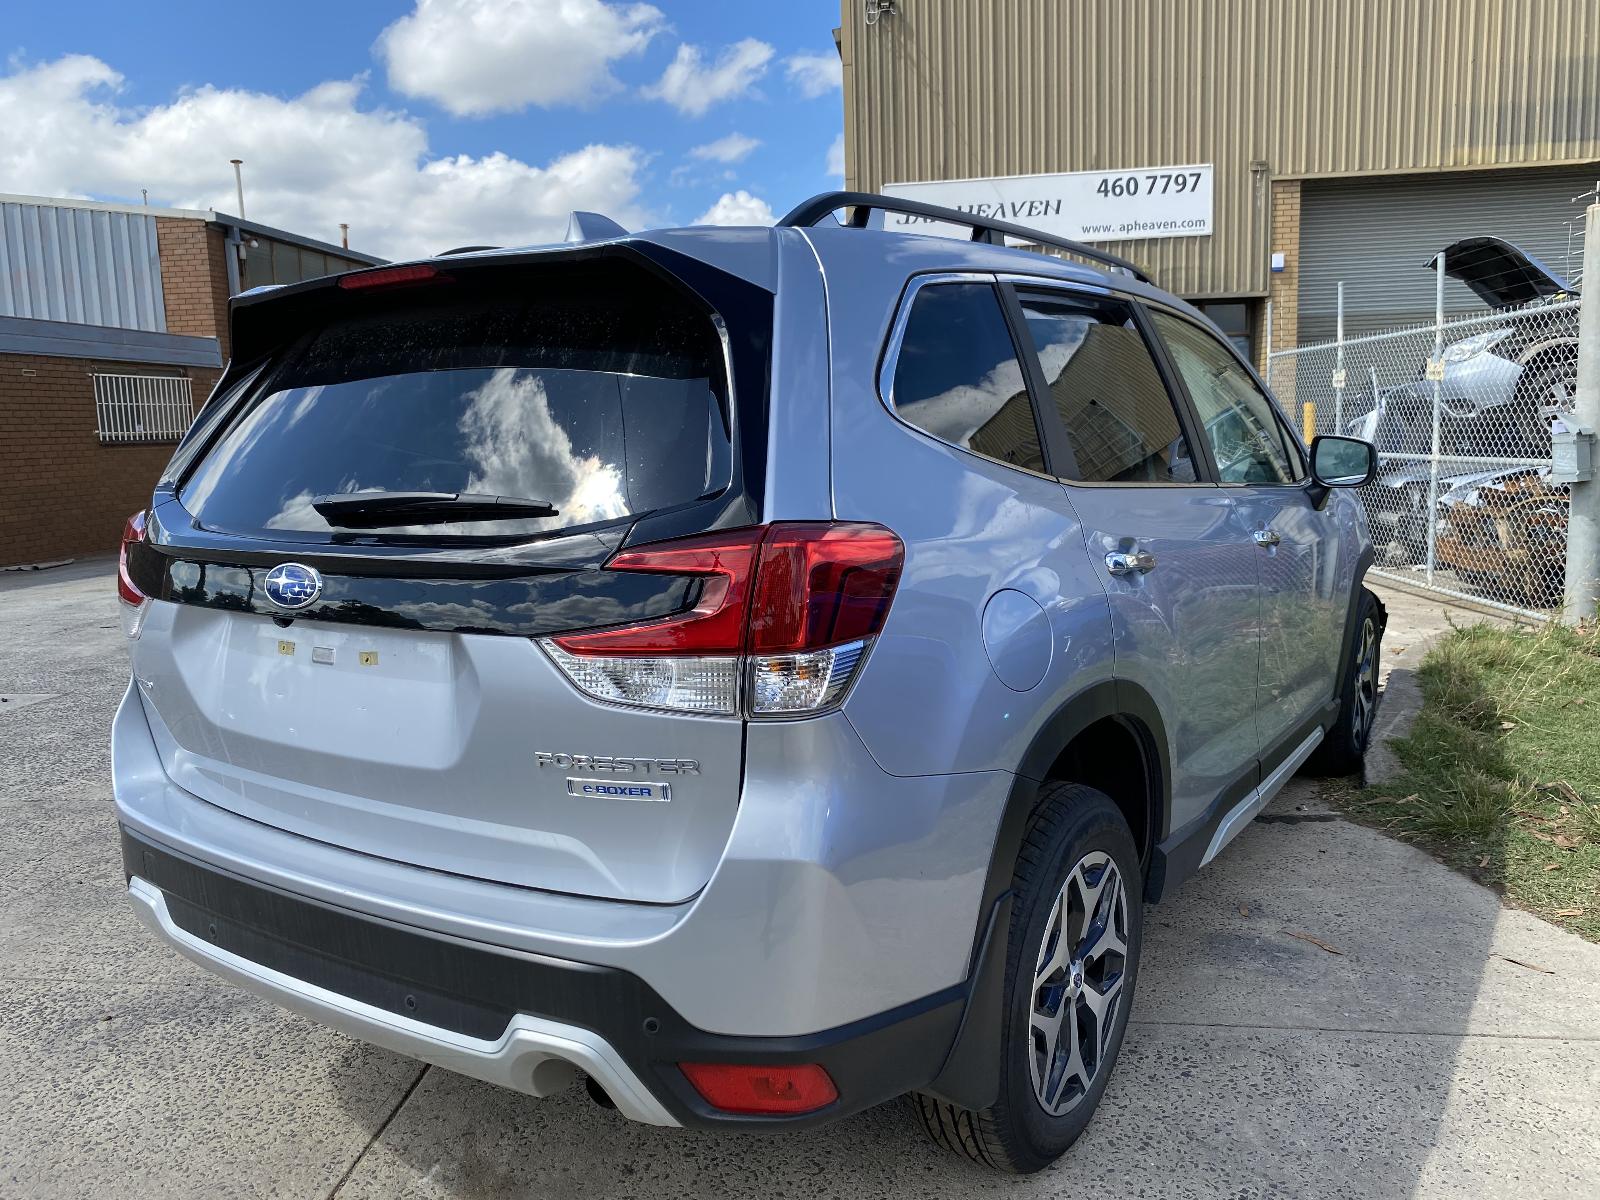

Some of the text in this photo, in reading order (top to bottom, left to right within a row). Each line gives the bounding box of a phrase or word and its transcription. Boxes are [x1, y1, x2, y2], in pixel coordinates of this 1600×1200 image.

[1096, 172, 1202, 198] 460 7797
[534, 751, 701, 776] FORESTER
[582, 784, 653, 797] e-BOXER
